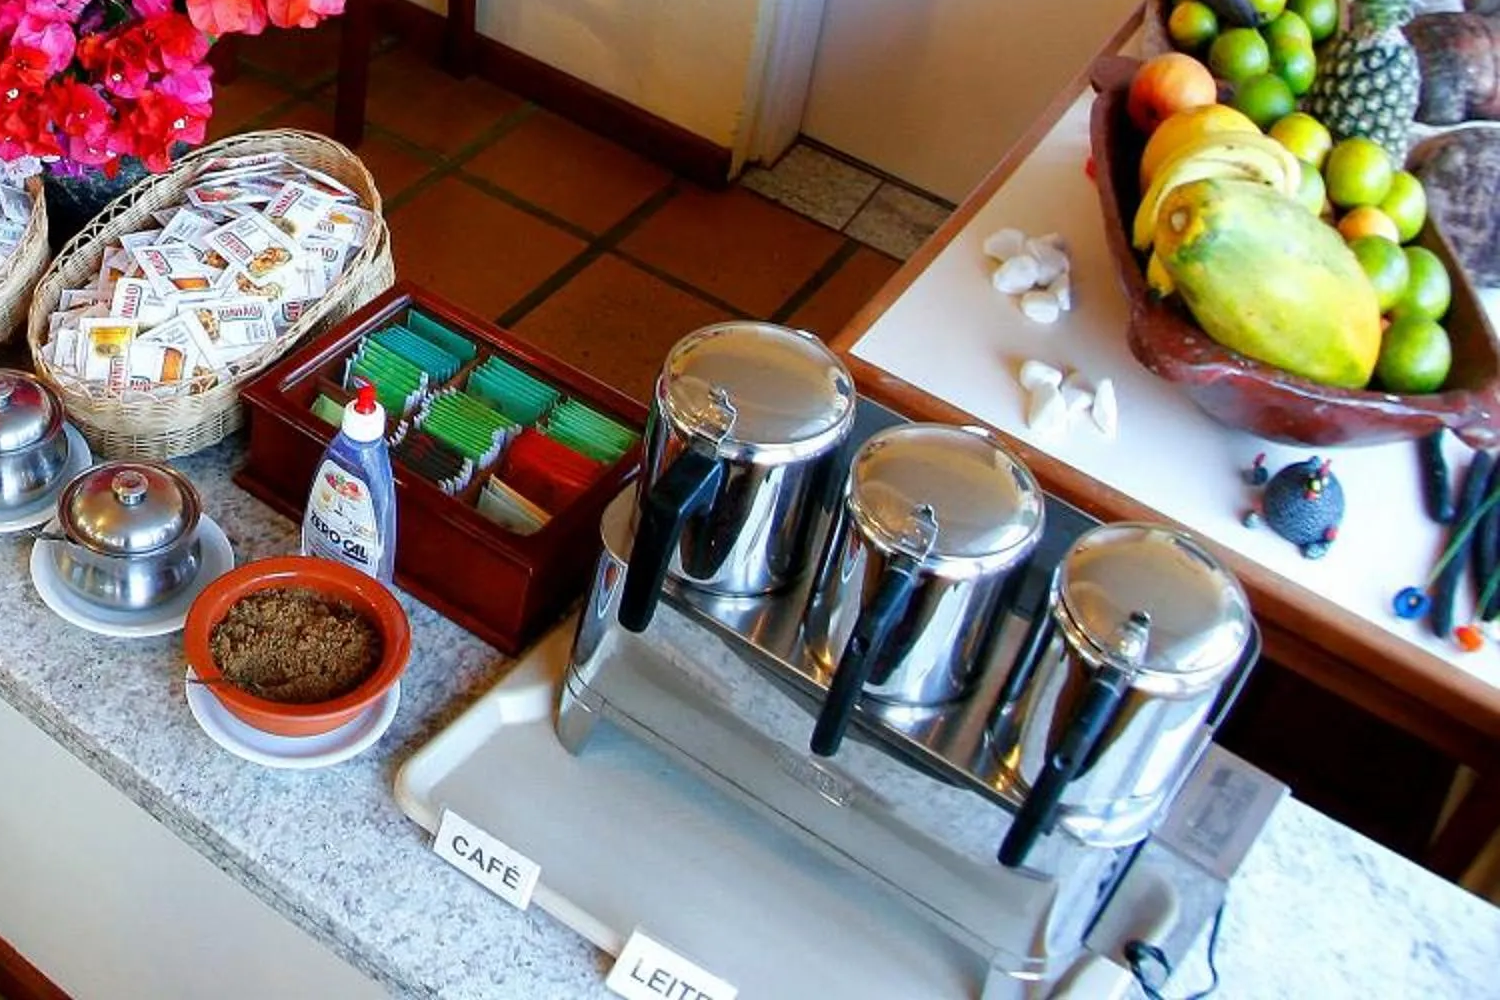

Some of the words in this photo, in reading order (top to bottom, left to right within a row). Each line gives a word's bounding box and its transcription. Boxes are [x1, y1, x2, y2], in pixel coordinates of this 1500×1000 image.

[311, 510, 341, 544] ZERO
[343, 539, 369, 561] CAL
[452, 835, 520, 890] CAFÉ
